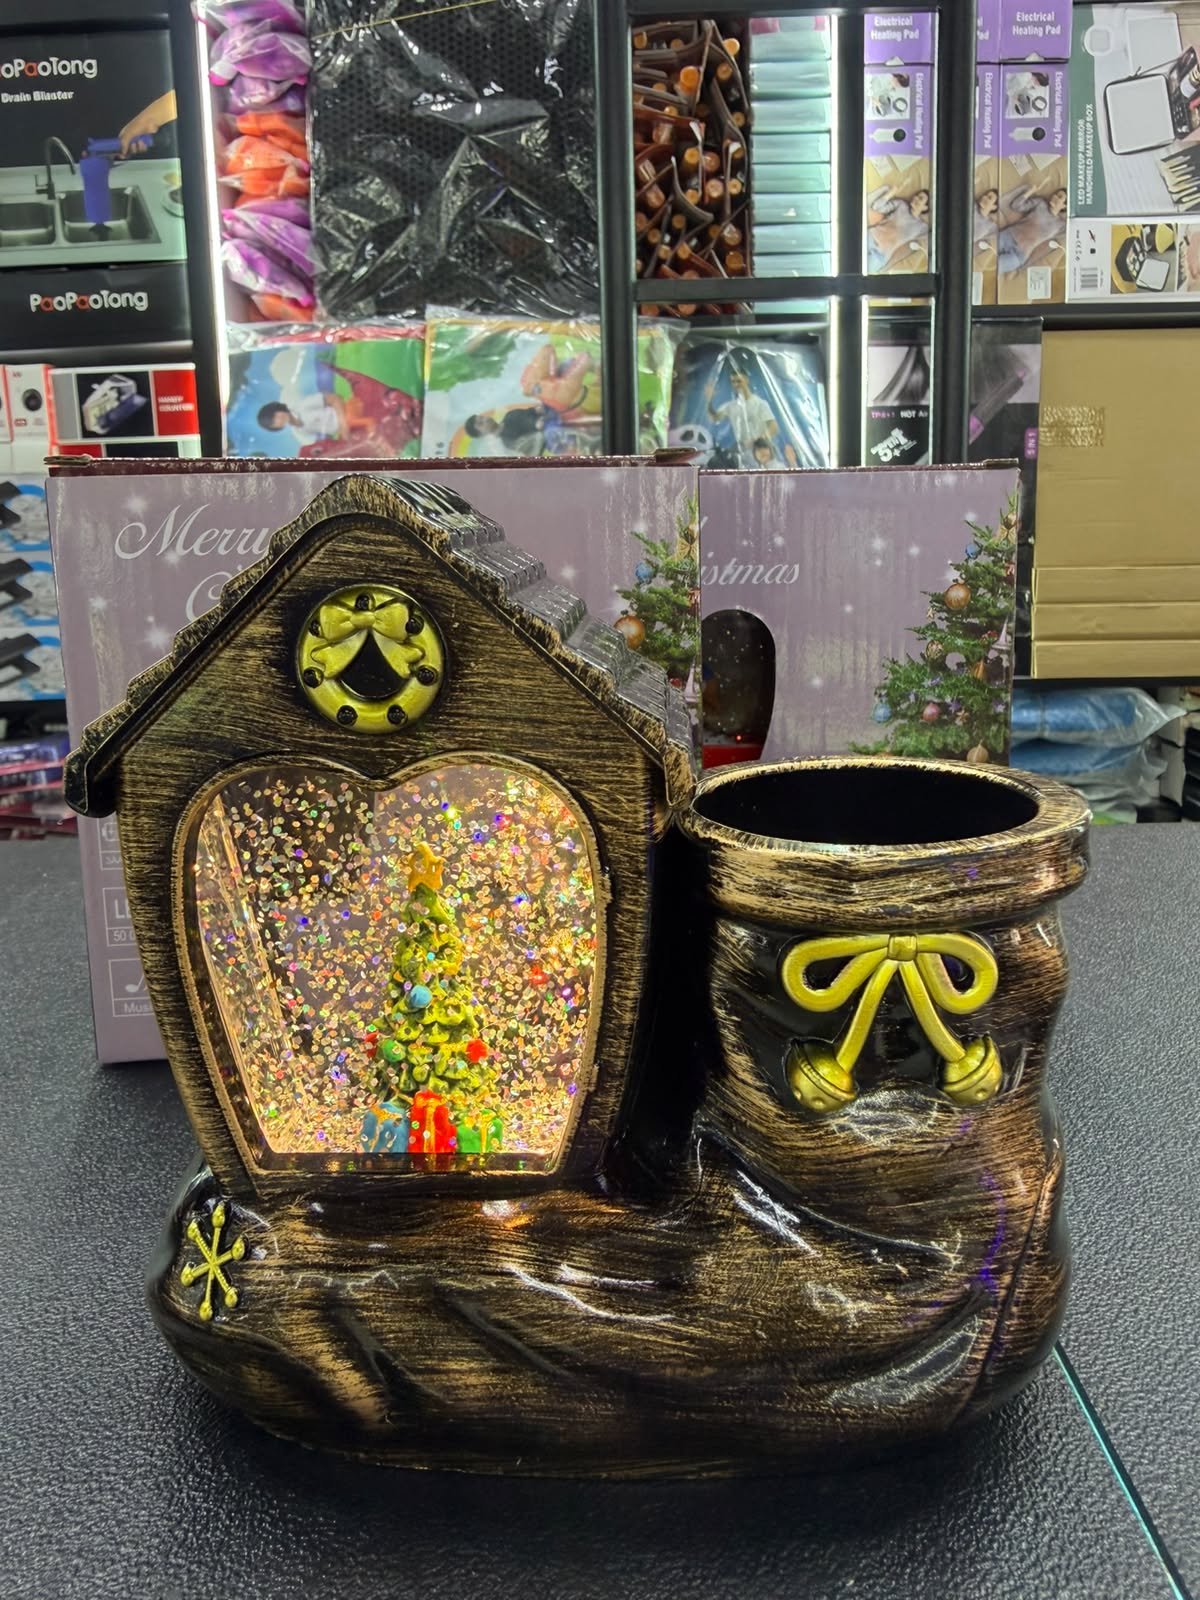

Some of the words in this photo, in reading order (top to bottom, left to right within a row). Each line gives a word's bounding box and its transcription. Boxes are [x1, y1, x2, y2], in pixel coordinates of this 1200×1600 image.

[874, 15, 913, 27] Electrical
[1016, 11, 1055, 22] Electrical
[871, 30, 902, 41] Heating
[904, 29, 919, 39] Pad
[1012, 25, 1043, 38] Heating
[1045, 24, 1061, 35] Pad
[0, 57, 98, 79] oPaoTong
[1, 92, 31, 103] Drain
[33, 90, 74, 101] Blaster
[916, 72, 924, 106] Electrical
[985, 72, 993, 106] Electrical
[1055, 71, 1063, 104] Electrical
[913, 107, 924, 134] Heating
[982, 106, 992, 133] Heating
[1053, 105, 1063, 132] Heating
[915, 135, 924, 149] Pad
[984, 135, 992, 149] Pad
[1054, 134, 1063, 148] Pad
[29, 290, 149, 313] PaoPaoTong
[700, 551, 800, 585] istmas
